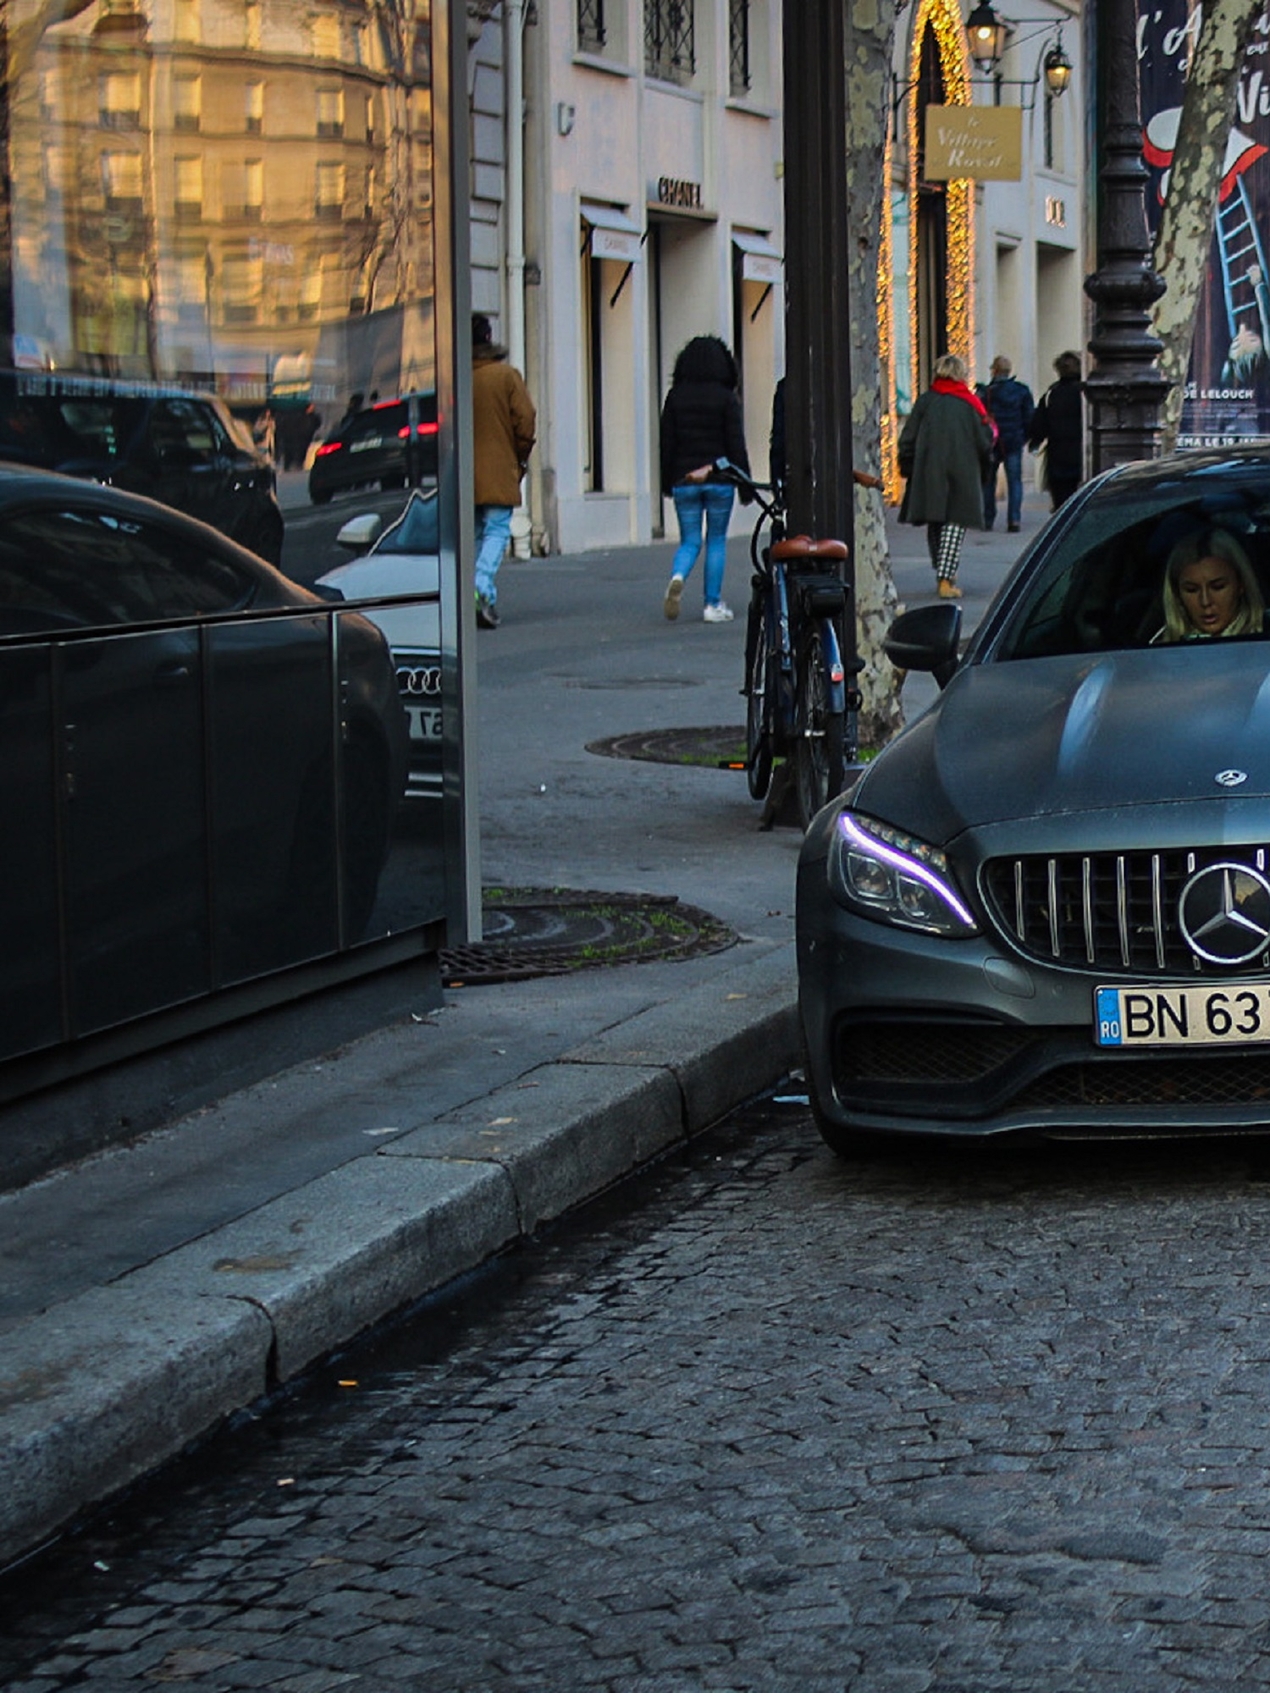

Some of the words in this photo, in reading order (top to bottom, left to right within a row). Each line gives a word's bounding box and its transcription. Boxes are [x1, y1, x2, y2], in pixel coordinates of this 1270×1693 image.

[658, 176, 704, 209] CHANEL
[1201, 389, 1254, 399] LELOUCH
[1124, 993, 1189, 1038] BN
[1205, 991, 1261, 1036] 63
[1101, 1022, 1120, 1039] RO
